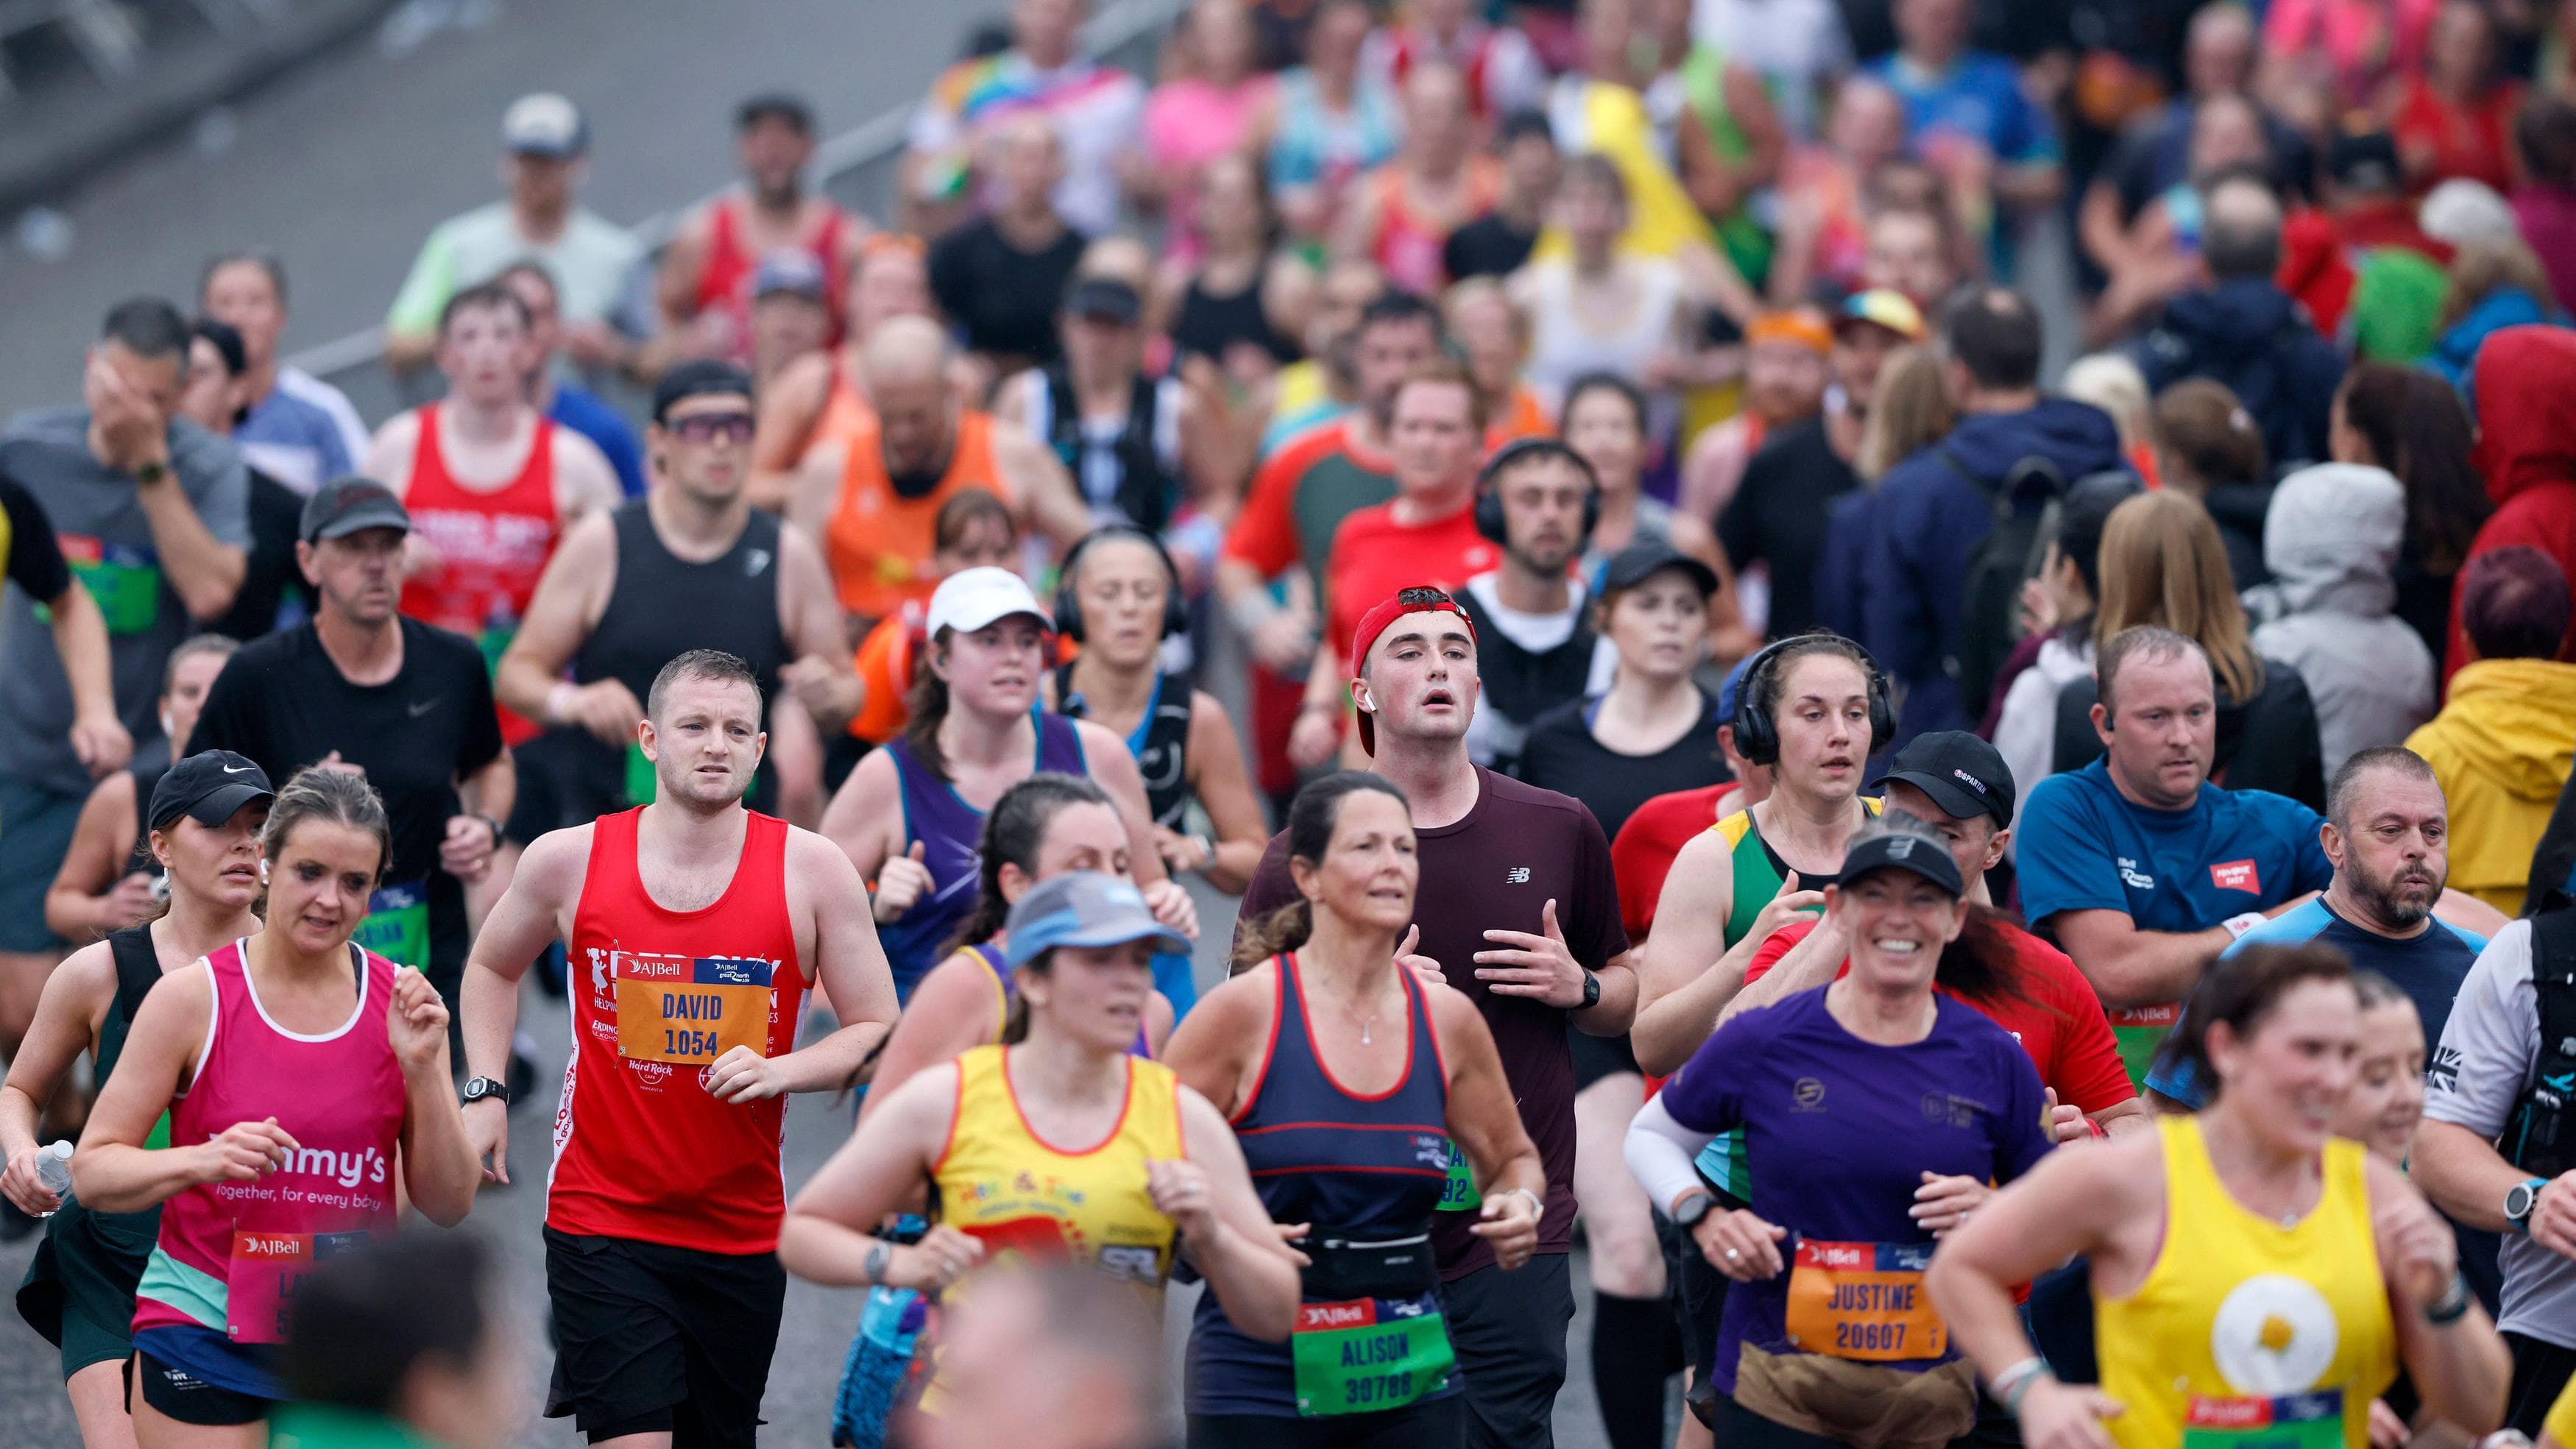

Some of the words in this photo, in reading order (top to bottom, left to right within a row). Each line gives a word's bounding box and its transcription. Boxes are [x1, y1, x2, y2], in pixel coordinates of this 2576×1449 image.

[1961, 773, 1987, 794] SPARTAN
[1506, 867, 1531, 884] NB
[640, 962, 681, 977] AJBell
[720, 963, 737, 971] AJBell
[594, 996, 618, 1013] HELPIN
[662, 993, 722, 1021] DAVID
[592, 1019, 618, 1035] ERDING
[592, 1030, 618, 1042] ALKOHO
[665, 1030, 718, 1056] 1054
[629, 1060, 651, 1071] Hard
[651, 1063, 673, 1076] Rock
[283, 1186, 302, 1201] for
[307, 1192, 348, 1208] every
[258, 1239, 300, 1255] AJBell
[1827, 1283, 1917, 1311] JUSTINE
[1836, 1322, 1907, 1350] 20607
[1342, 1331, 1409, 1367] ALISON
